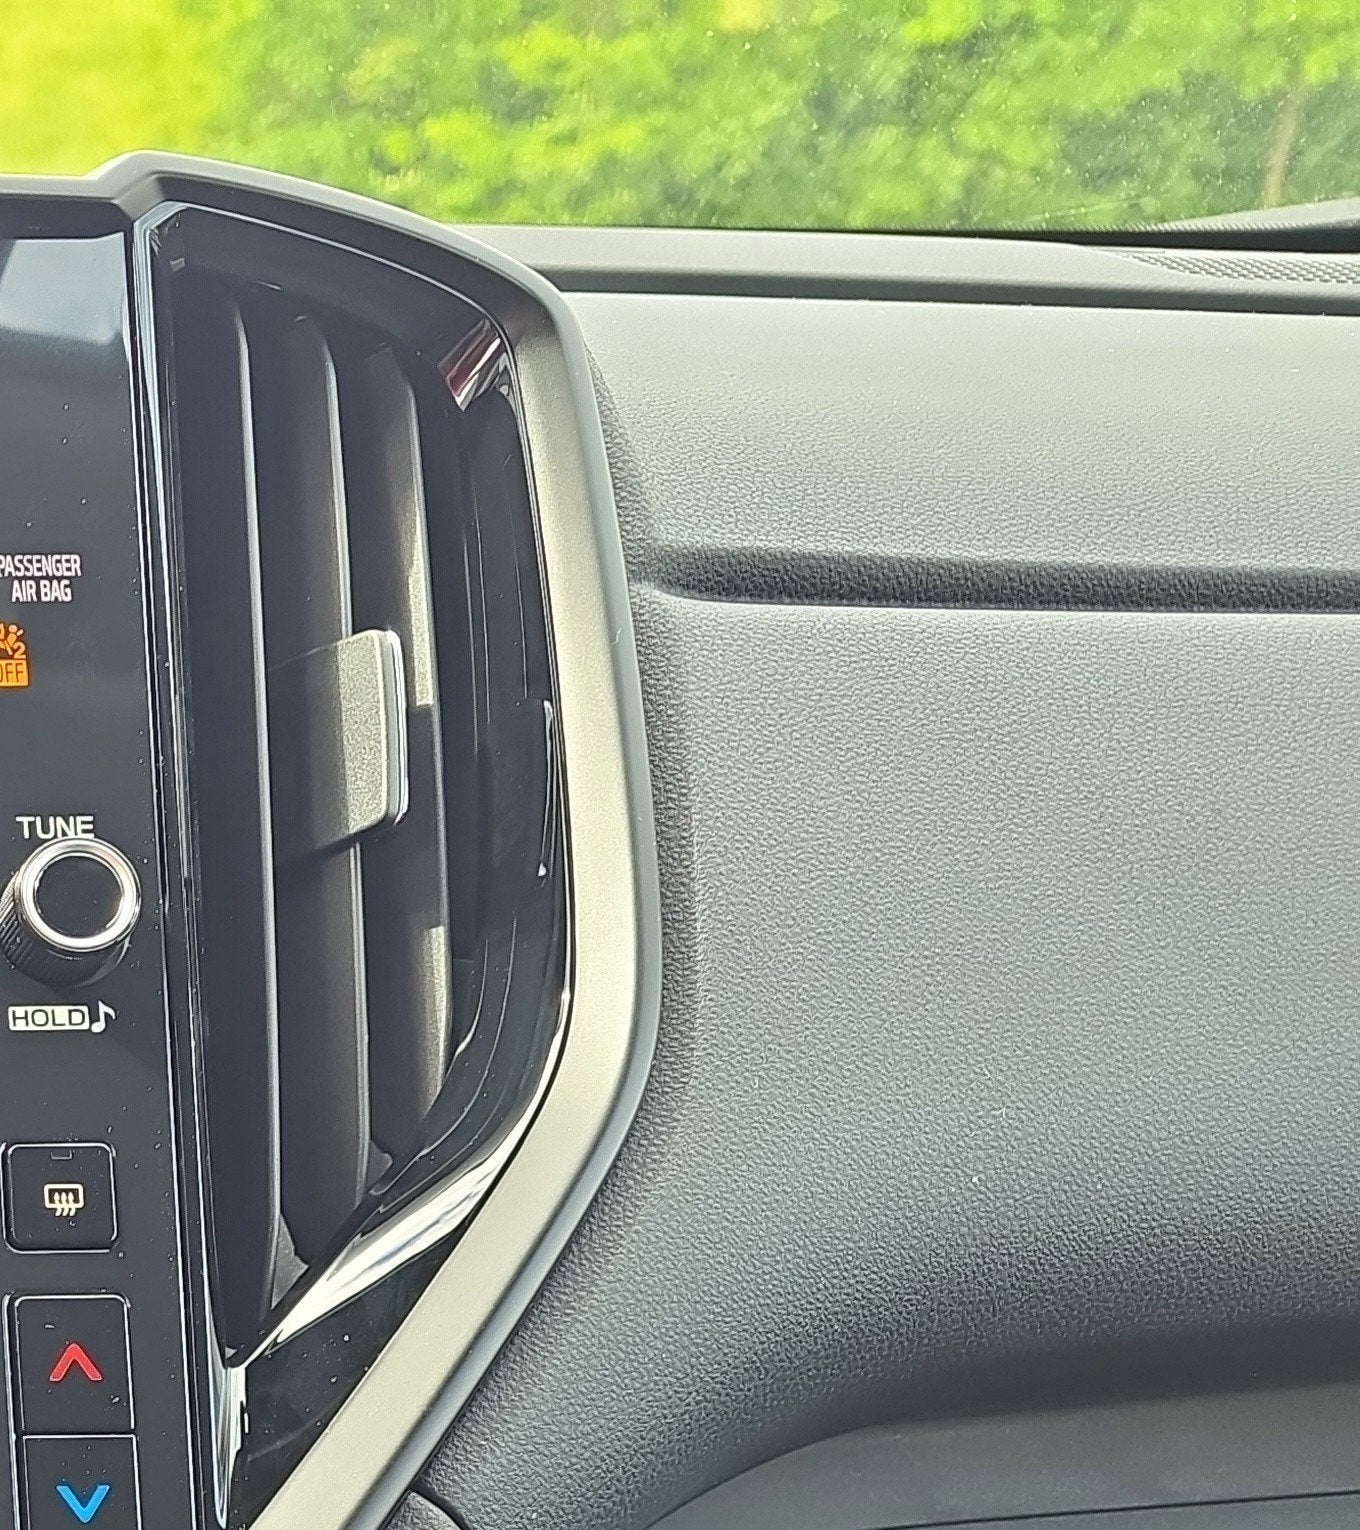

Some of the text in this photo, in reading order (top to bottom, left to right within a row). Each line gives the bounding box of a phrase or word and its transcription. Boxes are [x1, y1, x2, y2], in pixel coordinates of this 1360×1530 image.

[11, 580, 72, 602] AIR BAG
[16, 816, 95, 840] TUNE
[11, 1008, 86, 1029] HOLD
